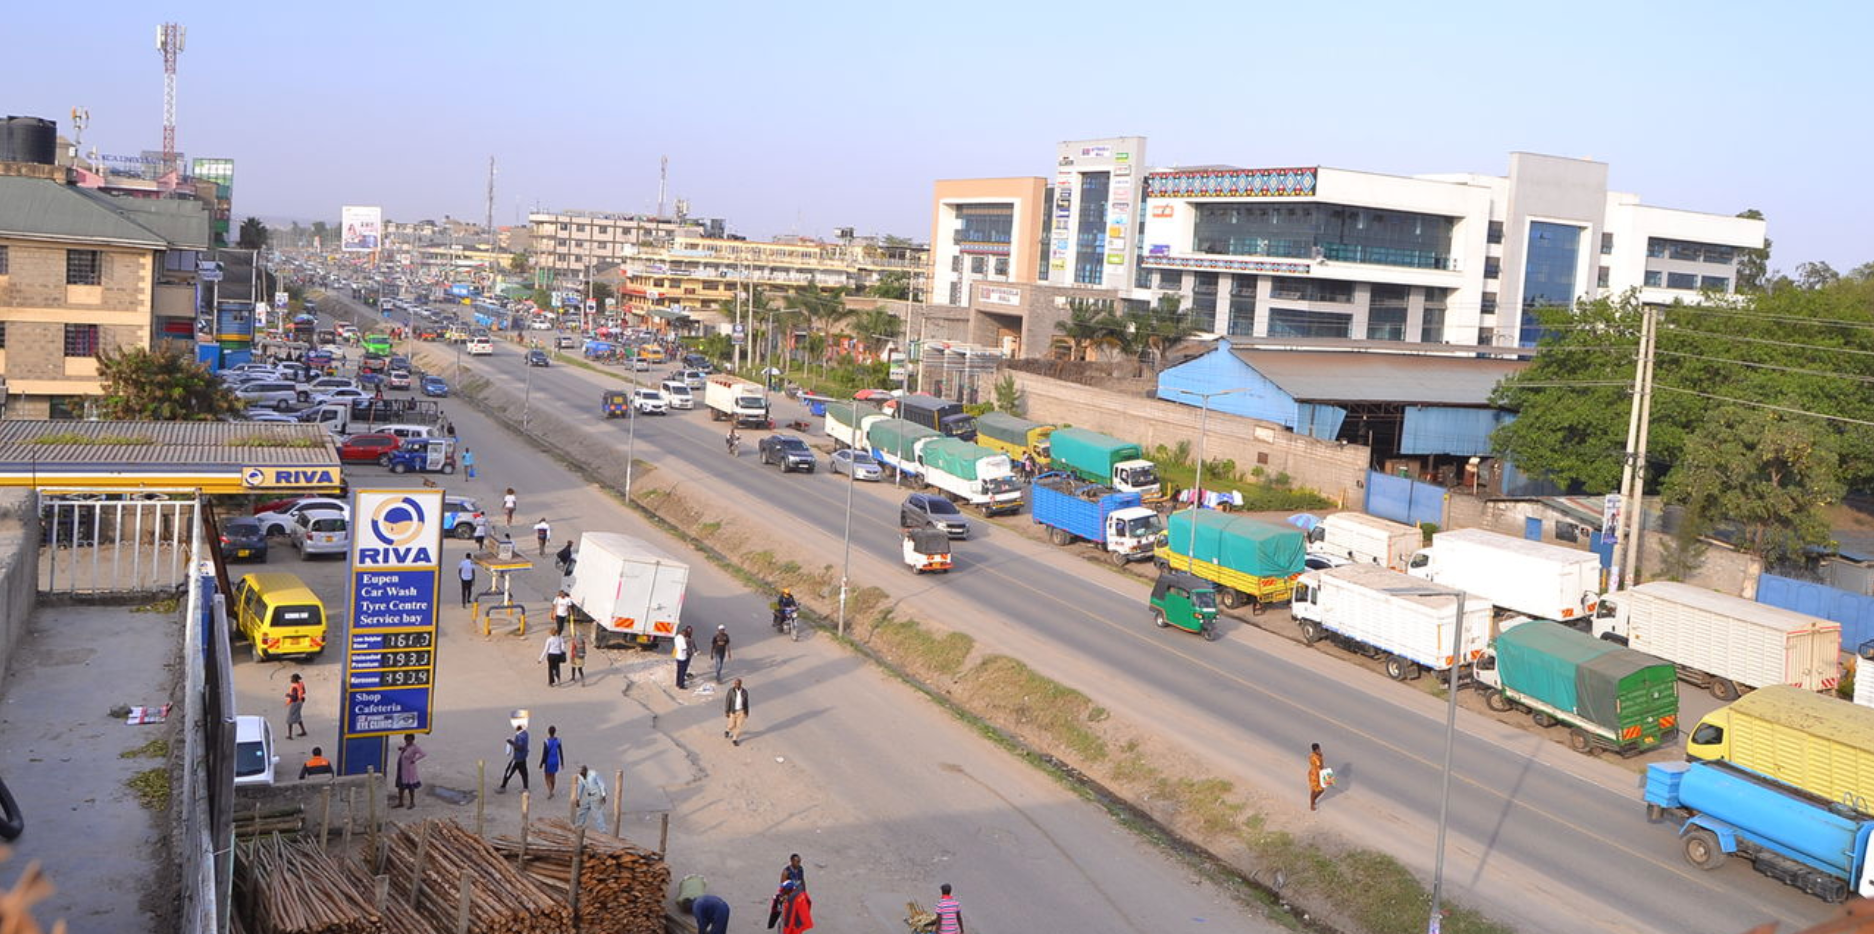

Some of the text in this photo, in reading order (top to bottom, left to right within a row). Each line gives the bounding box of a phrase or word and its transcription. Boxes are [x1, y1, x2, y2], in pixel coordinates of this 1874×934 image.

[275, 471, 334, 483] RIVA
[358, 547, 432, 565] RIVA
[362, 573, 400, 586] Eupen
[361, 586, 417, 597] Car Wash
[360, 600, 428, 613] Tyre Centre
[359, 613, 423, 625] Service bay
[355, 693, 381, 702] Shop
[355, 703, 402, 714] Cafeteria
